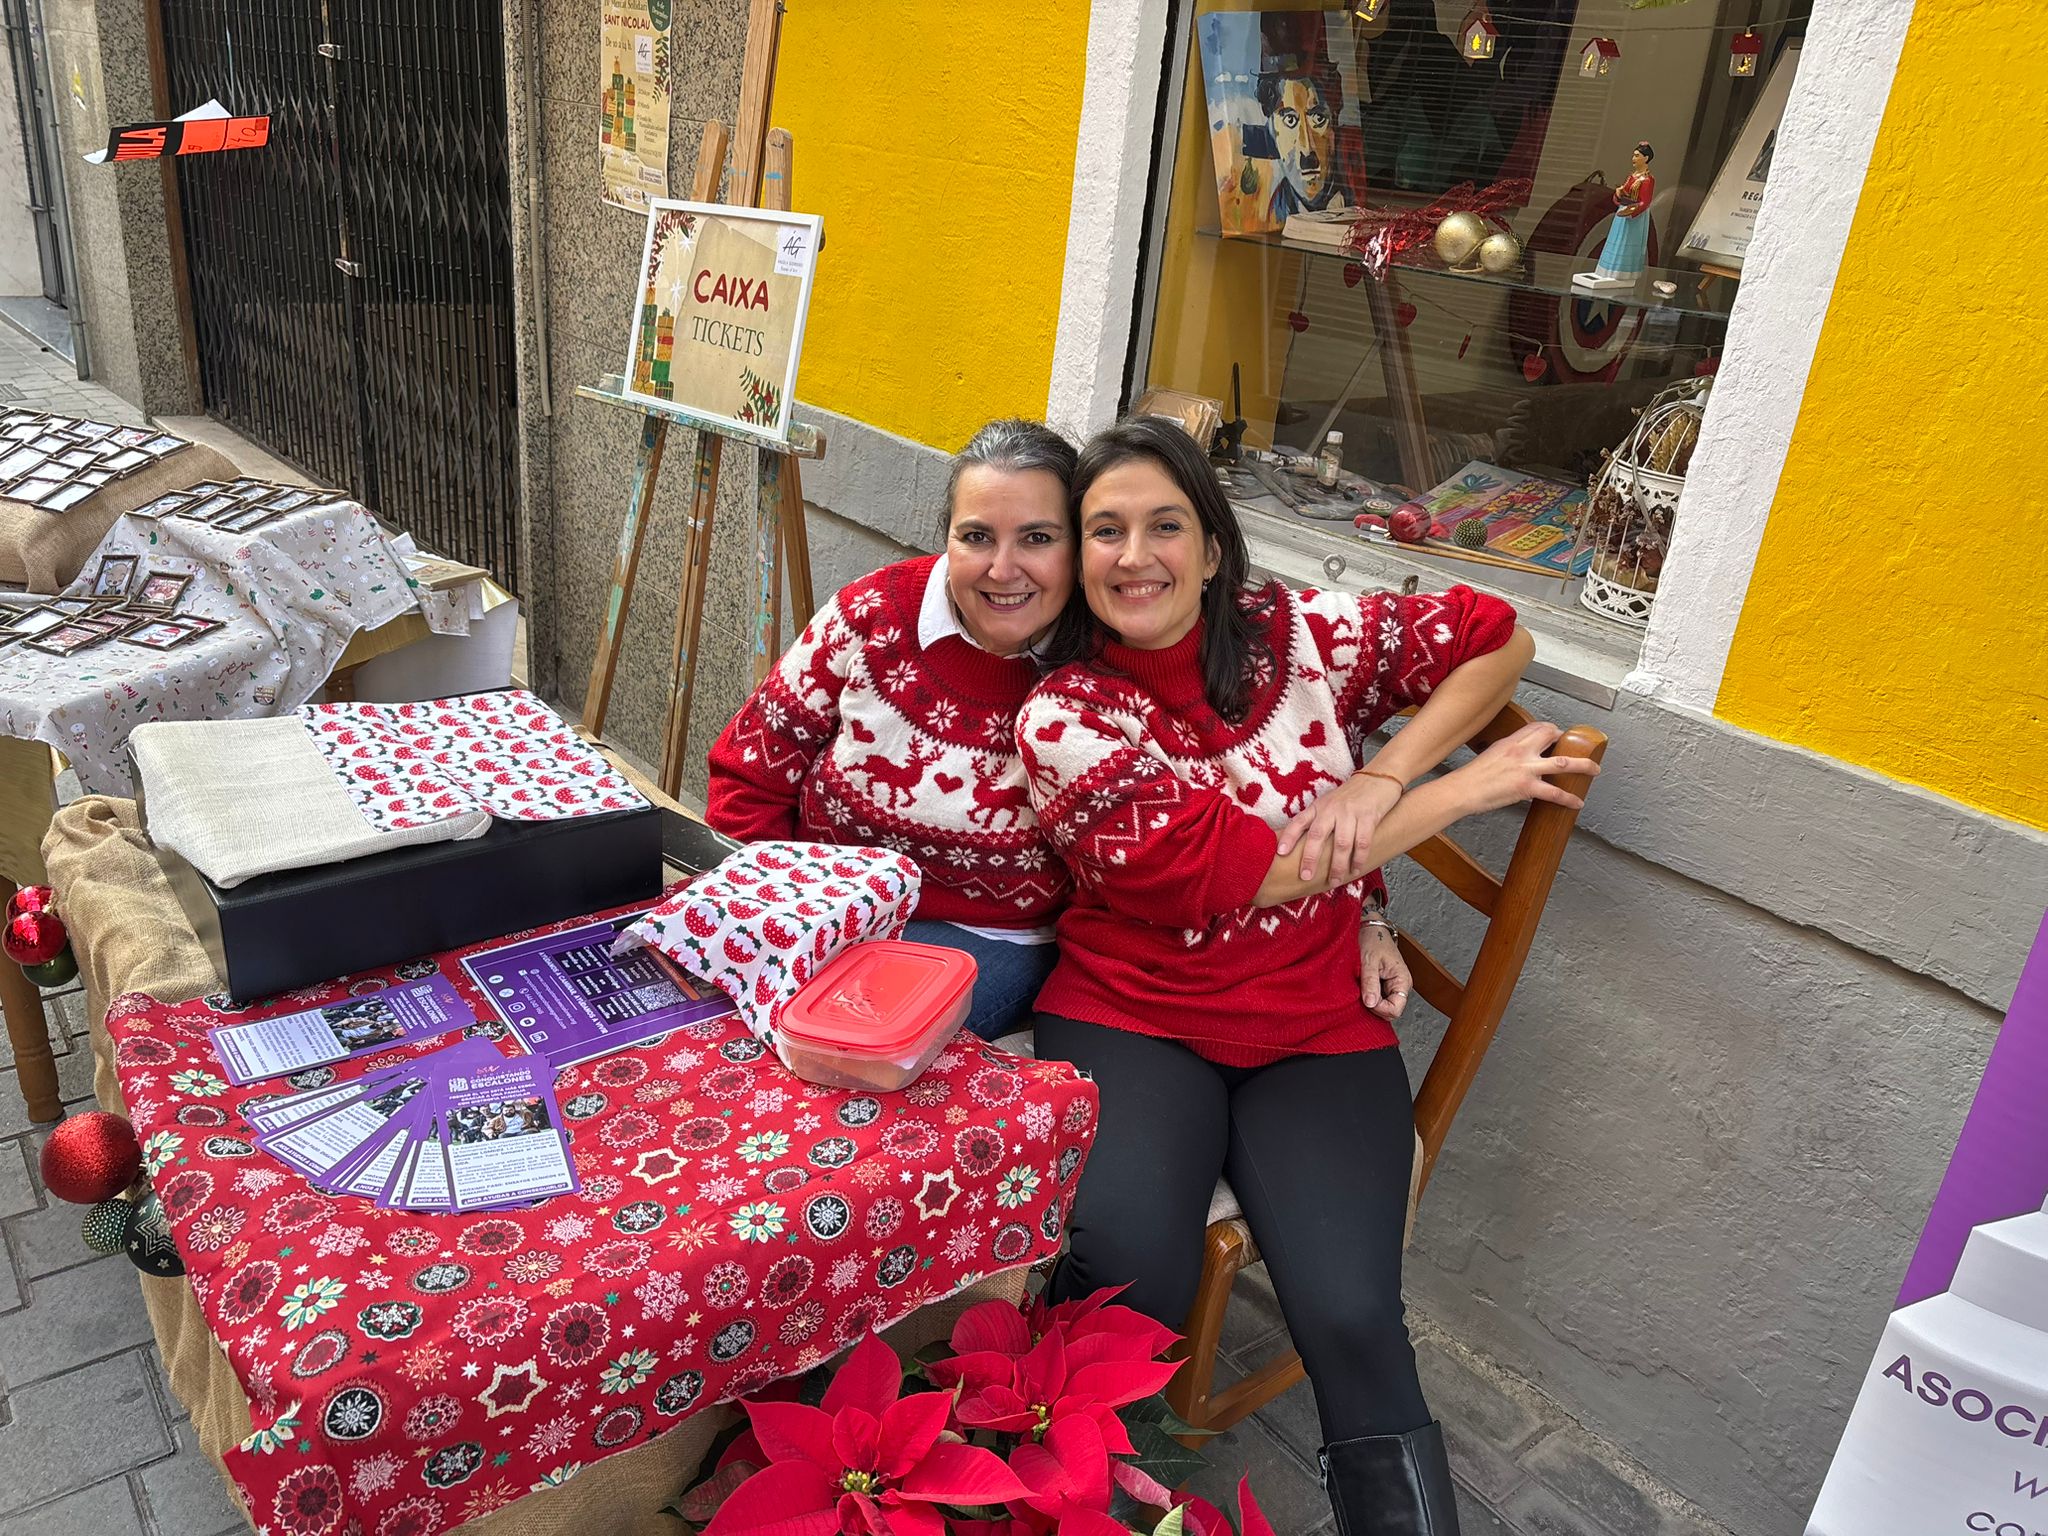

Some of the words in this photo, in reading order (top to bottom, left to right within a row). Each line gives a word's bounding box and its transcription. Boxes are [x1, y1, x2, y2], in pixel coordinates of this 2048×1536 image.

[604, 14, 619, 26] SANT
[621, 16, 650, 30] NICOLAU
[694, 269, 769, 312] CAIXA
[692, 316, 765, 357] TICKETS
[538, 951, 559, 971] AYÚDANOS
[572, 994, 596, 1018] AYÚDANOS
[594, 1022, 609, 1034] VIVIR
[416, 996, 442, 1024] ESCALONES
[470, 1070, 530, 1083] CONQUISTANDO
[470, 1074, 532, 1089] ESCALONES
[1882, 1354, 2048, 1448] ASOCI
